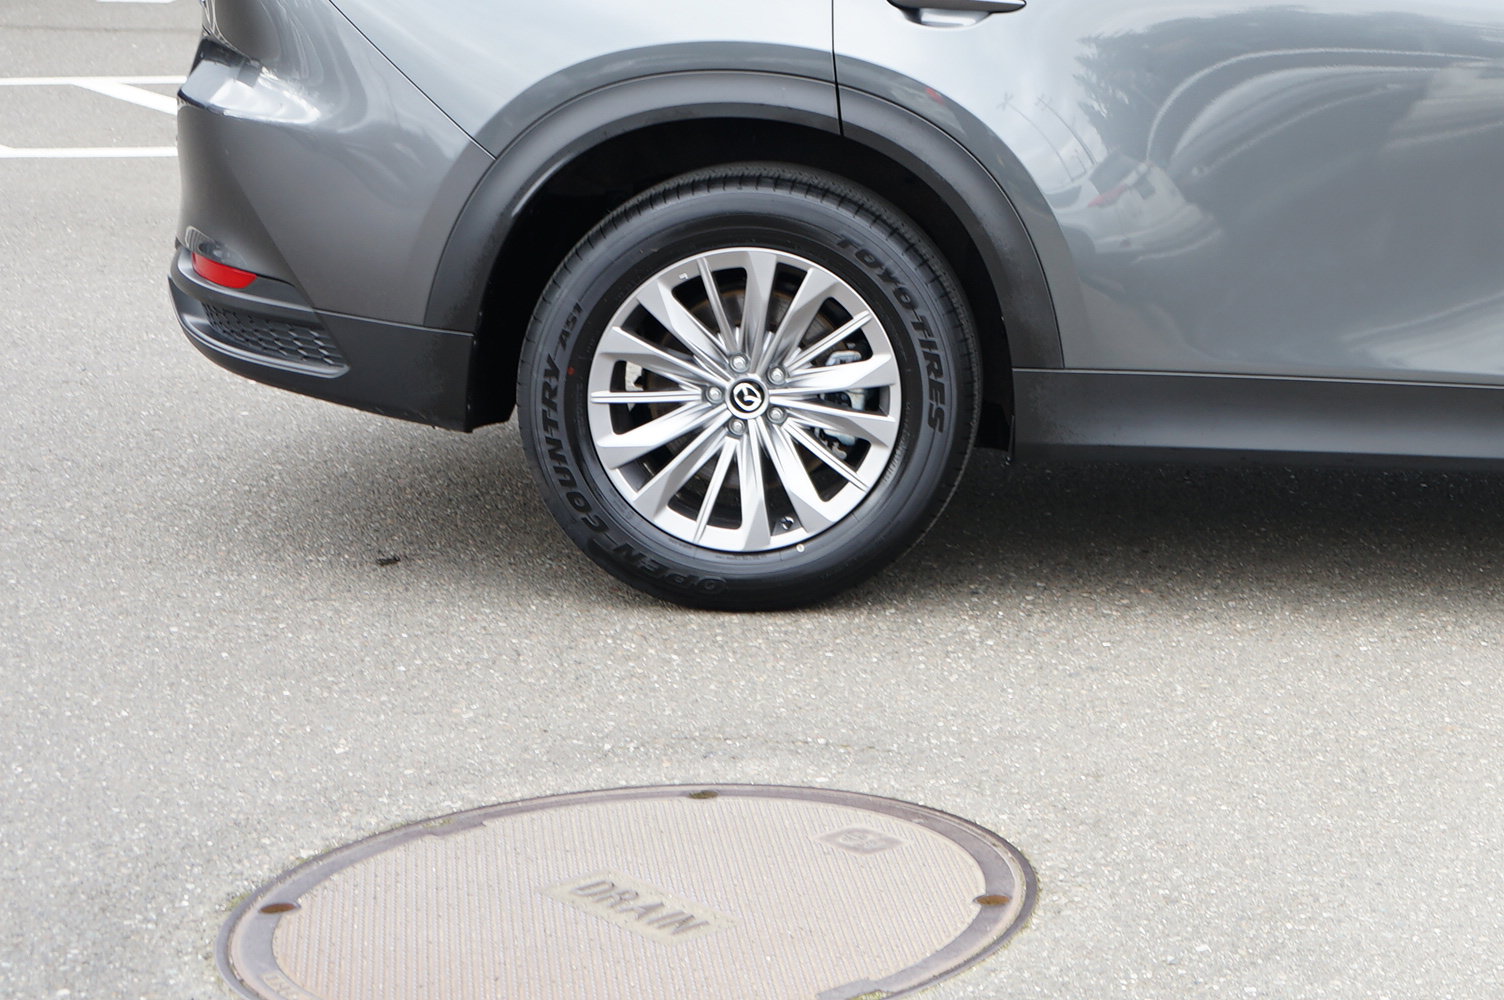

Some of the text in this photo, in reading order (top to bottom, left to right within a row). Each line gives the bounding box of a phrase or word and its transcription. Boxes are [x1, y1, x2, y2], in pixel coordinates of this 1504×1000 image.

[835, 233, 946, 434] TOYO TIRES
[541, 352, 601, 531] COUNTRY
[612, 544, 727, 594] OPEN
[570, 879, 711, 936] DRAIN
